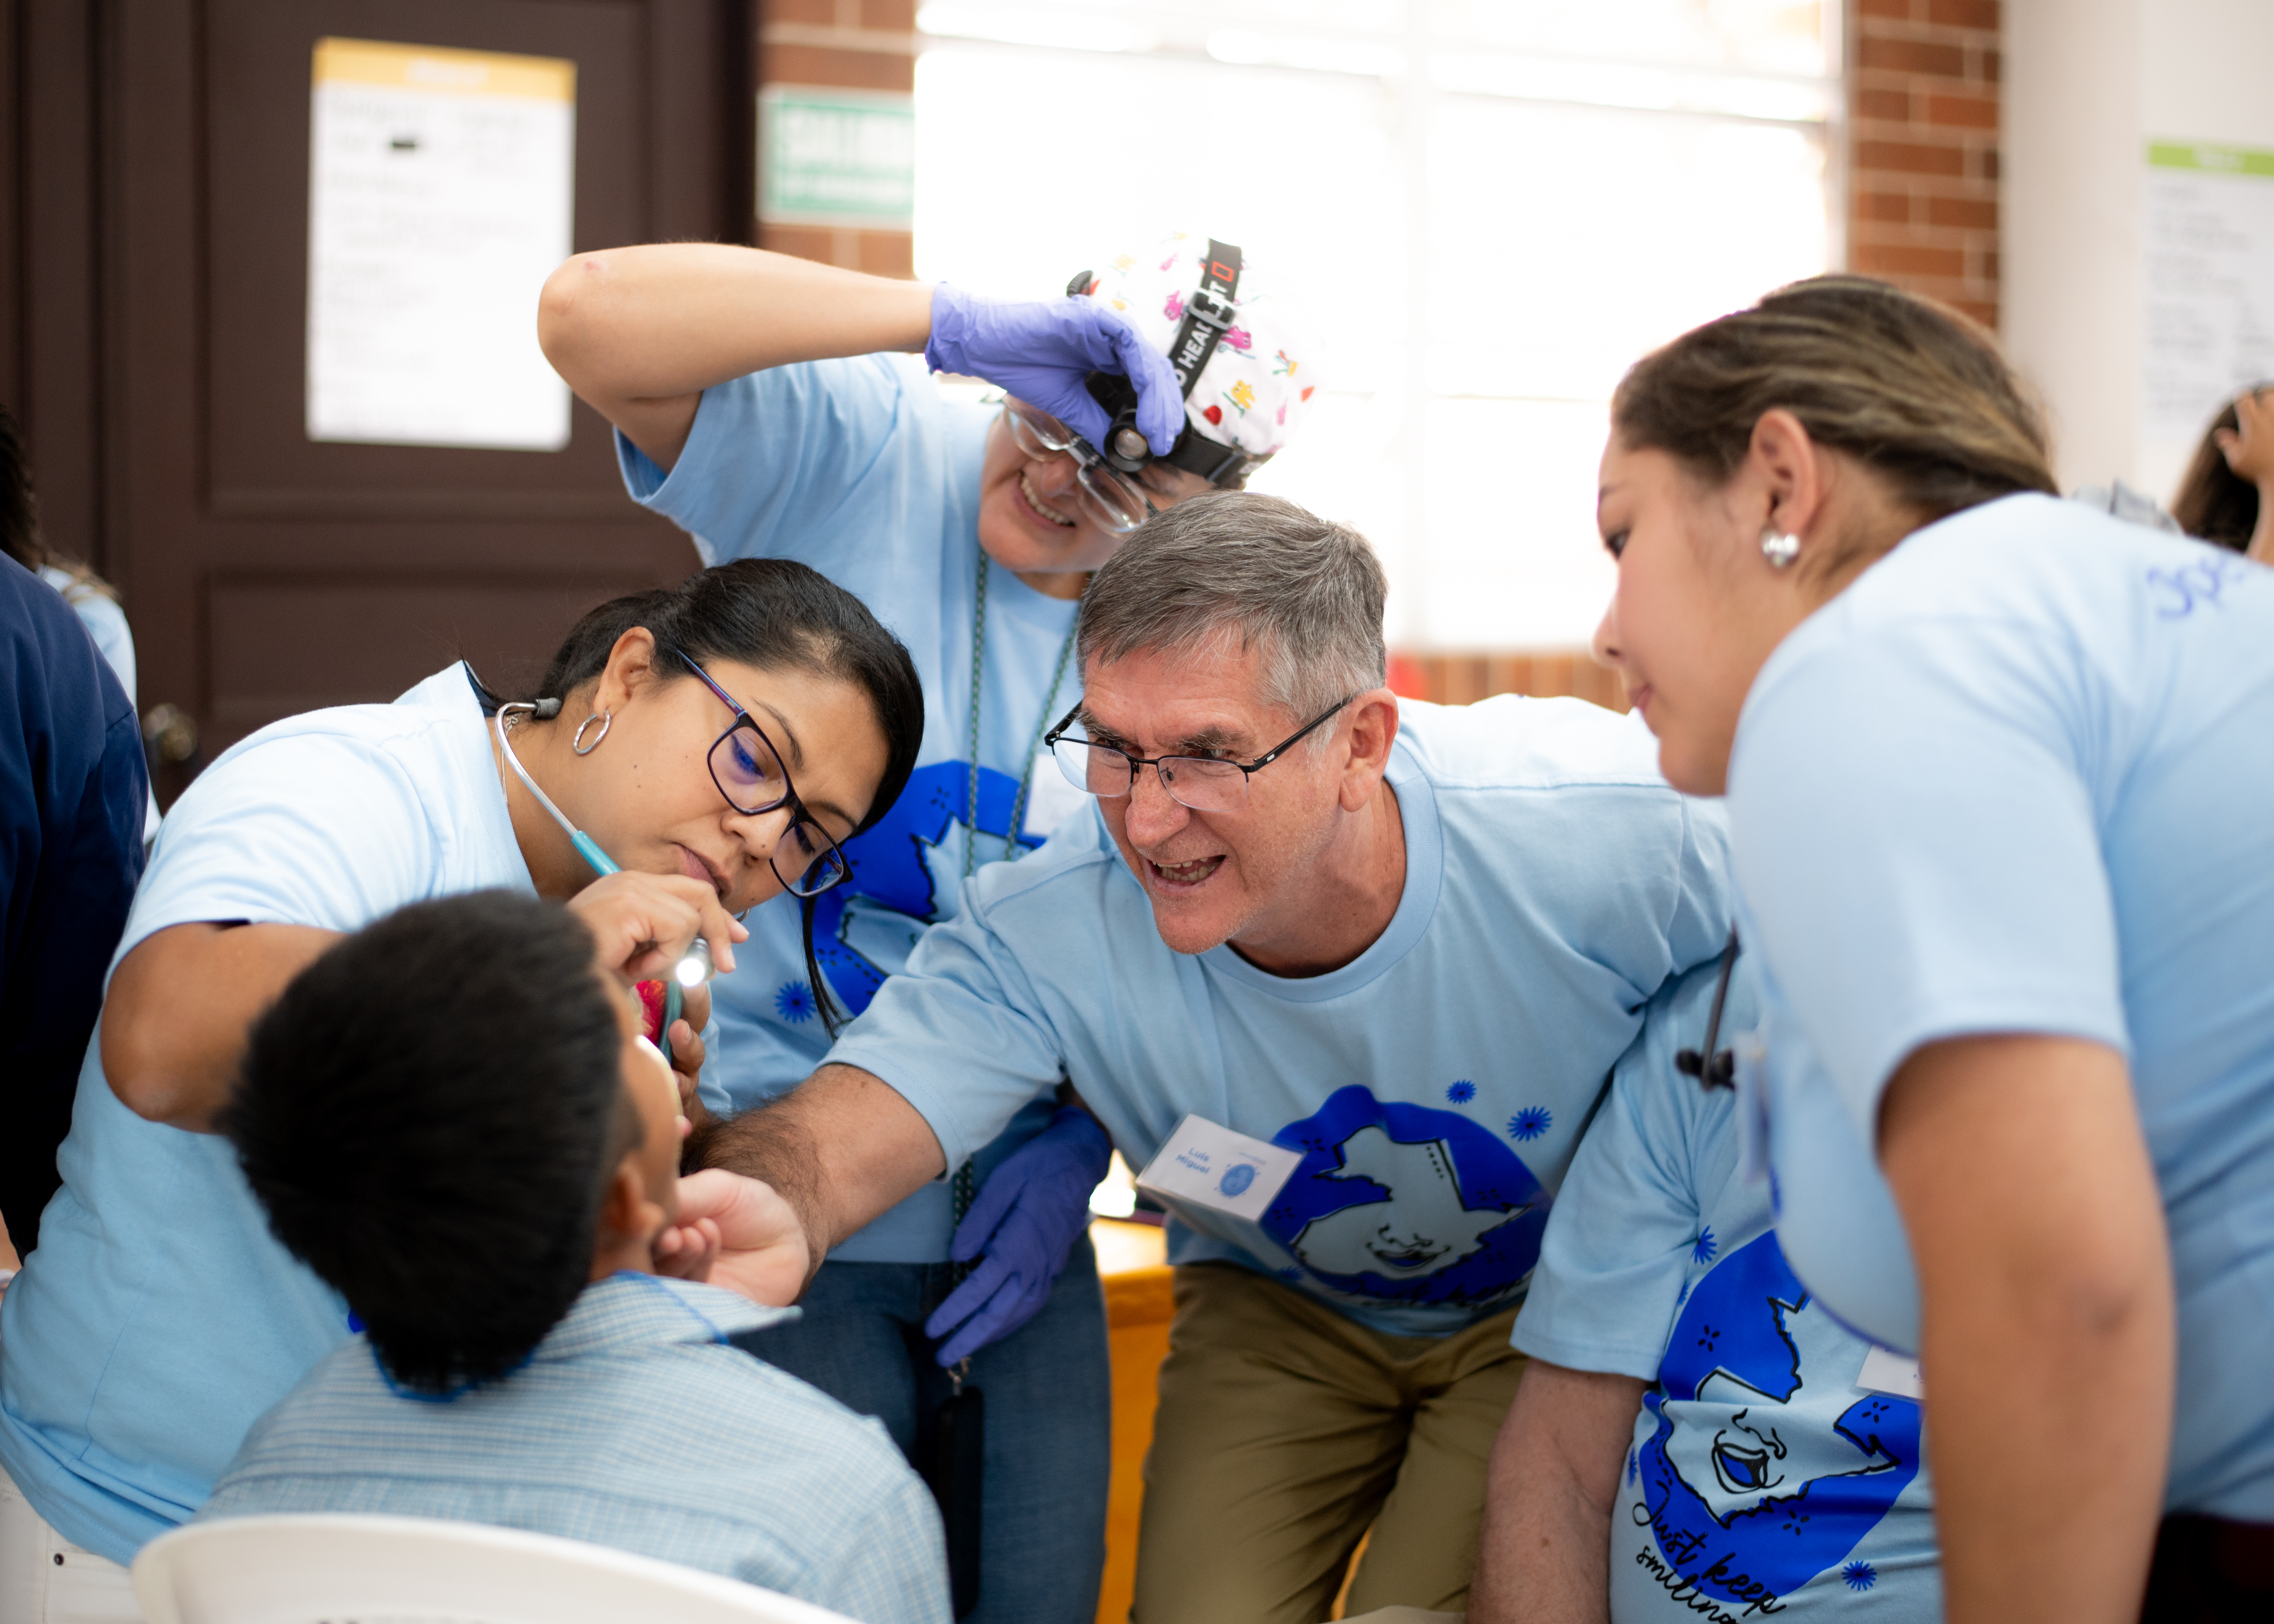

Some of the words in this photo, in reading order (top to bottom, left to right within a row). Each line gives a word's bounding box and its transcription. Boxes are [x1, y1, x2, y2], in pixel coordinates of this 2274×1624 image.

[1175, 1154, 1211, 1174] Miguel
[1188, 1147, 1210, 1162] Luis
[1632, 1479, 1708, 1565] Just
[1701, 1552, 1787, 1617] keep
